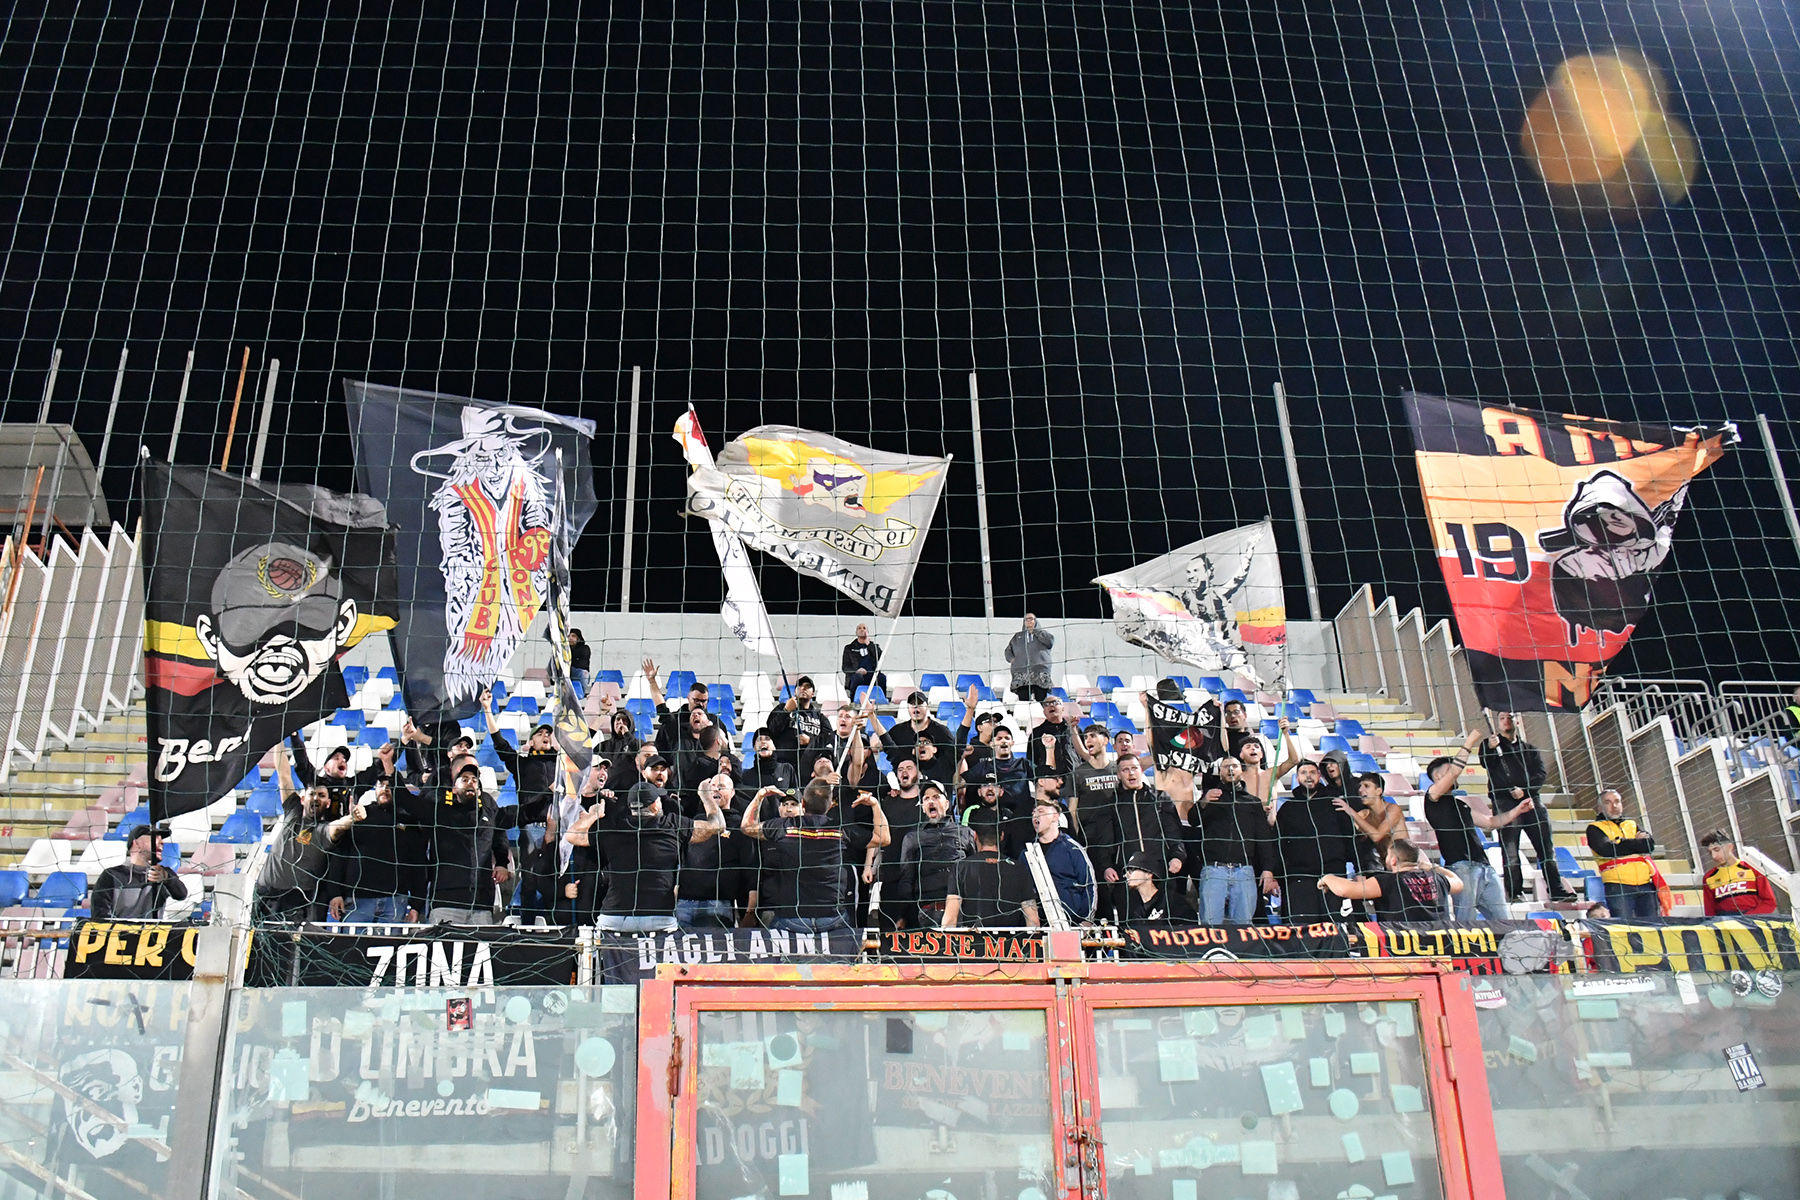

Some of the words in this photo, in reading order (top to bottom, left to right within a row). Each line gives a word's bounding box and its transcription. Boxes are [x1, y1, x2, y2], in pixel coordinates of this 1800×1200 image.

[1445, 522, 1533, 584] 19
[474, 557, 498, 630] CLUB
[1715, 881, 1747, 897] IVPC
[75, 922, 172, 967] PER
[637, 932, 737, 970] DAGLI
[750, 928, 831, 959] ANNI
[886, 931, 976, 958] TESTE
[1150, 928, 1229, 946] MODO
[1386, 927, 1498, 956] ULTIMI
[362, 941, 496, 1007] ZONA
[64, 982, 157, 1030] NON
[1728, 1056, 1760, 1081] ILVA
[347, 1096, 491, 1122] Benevento
[737, 1118, 810, 1163] OGGI
